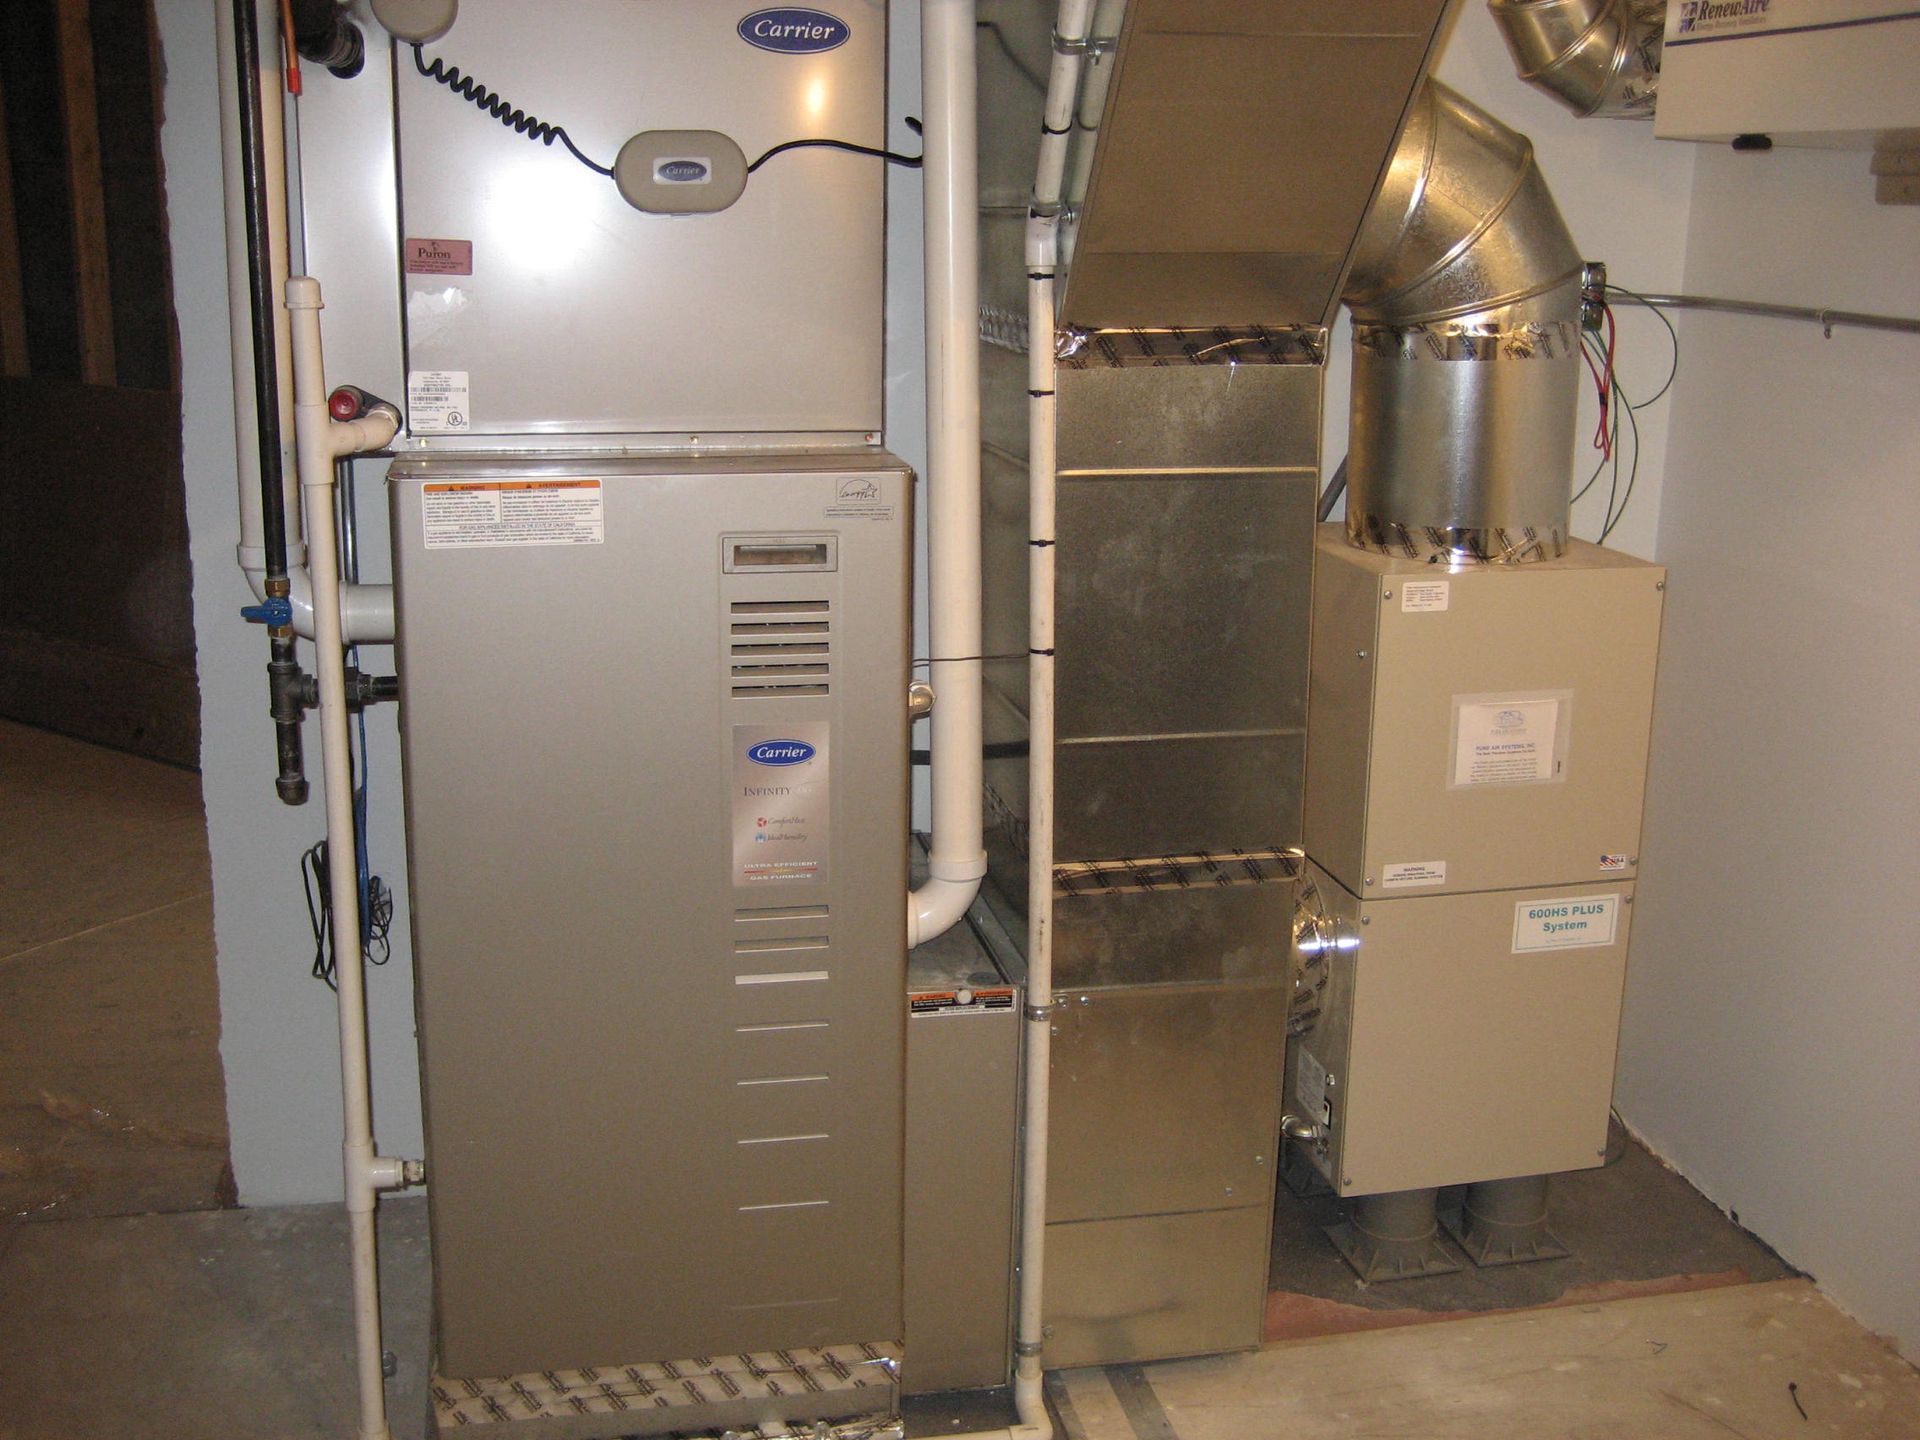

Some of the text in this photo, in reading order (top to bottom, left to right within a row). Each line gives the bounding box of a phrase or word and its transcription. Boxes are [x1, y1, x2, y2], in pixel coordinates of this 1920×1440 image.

[1698, 0, 1770, 20] RenewAire
[754, 19, 835, 39] Carrier
[666, 165, 701, 175] Carrier
[418, 247, 451, 259] Puron
[756, 746, 807, 759] Carrier
[744, 786, 792, 797] INFINITY
[1528, 904, 1605, 919] 600HS PLUS
[1543, 921, 1588, 933] System
